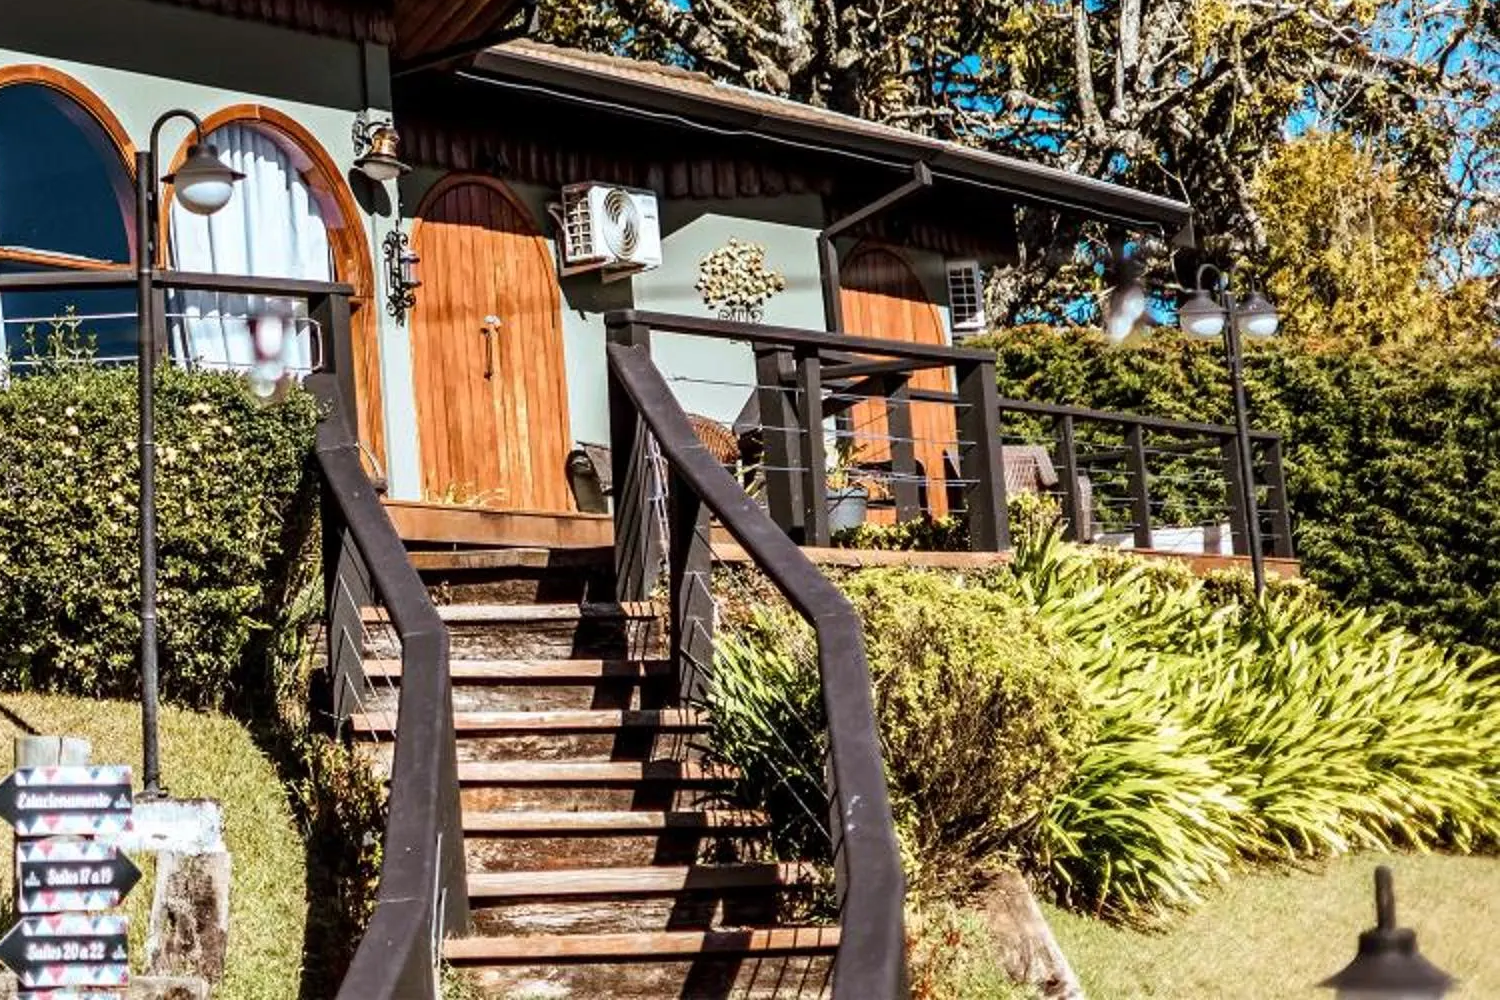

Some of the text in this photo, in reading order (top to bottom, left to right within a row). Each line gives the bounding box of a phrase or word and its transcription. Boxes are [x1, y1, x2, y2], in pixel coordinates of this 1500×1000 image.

[80, 867, 91, 884] 17
[91, 872, 99, 884] a
[101, 867, 112, 884] 19
[62, 942, 79, 960] 20
[80, 947, 88, 960] a
[90, 942, 105, 959] 22
